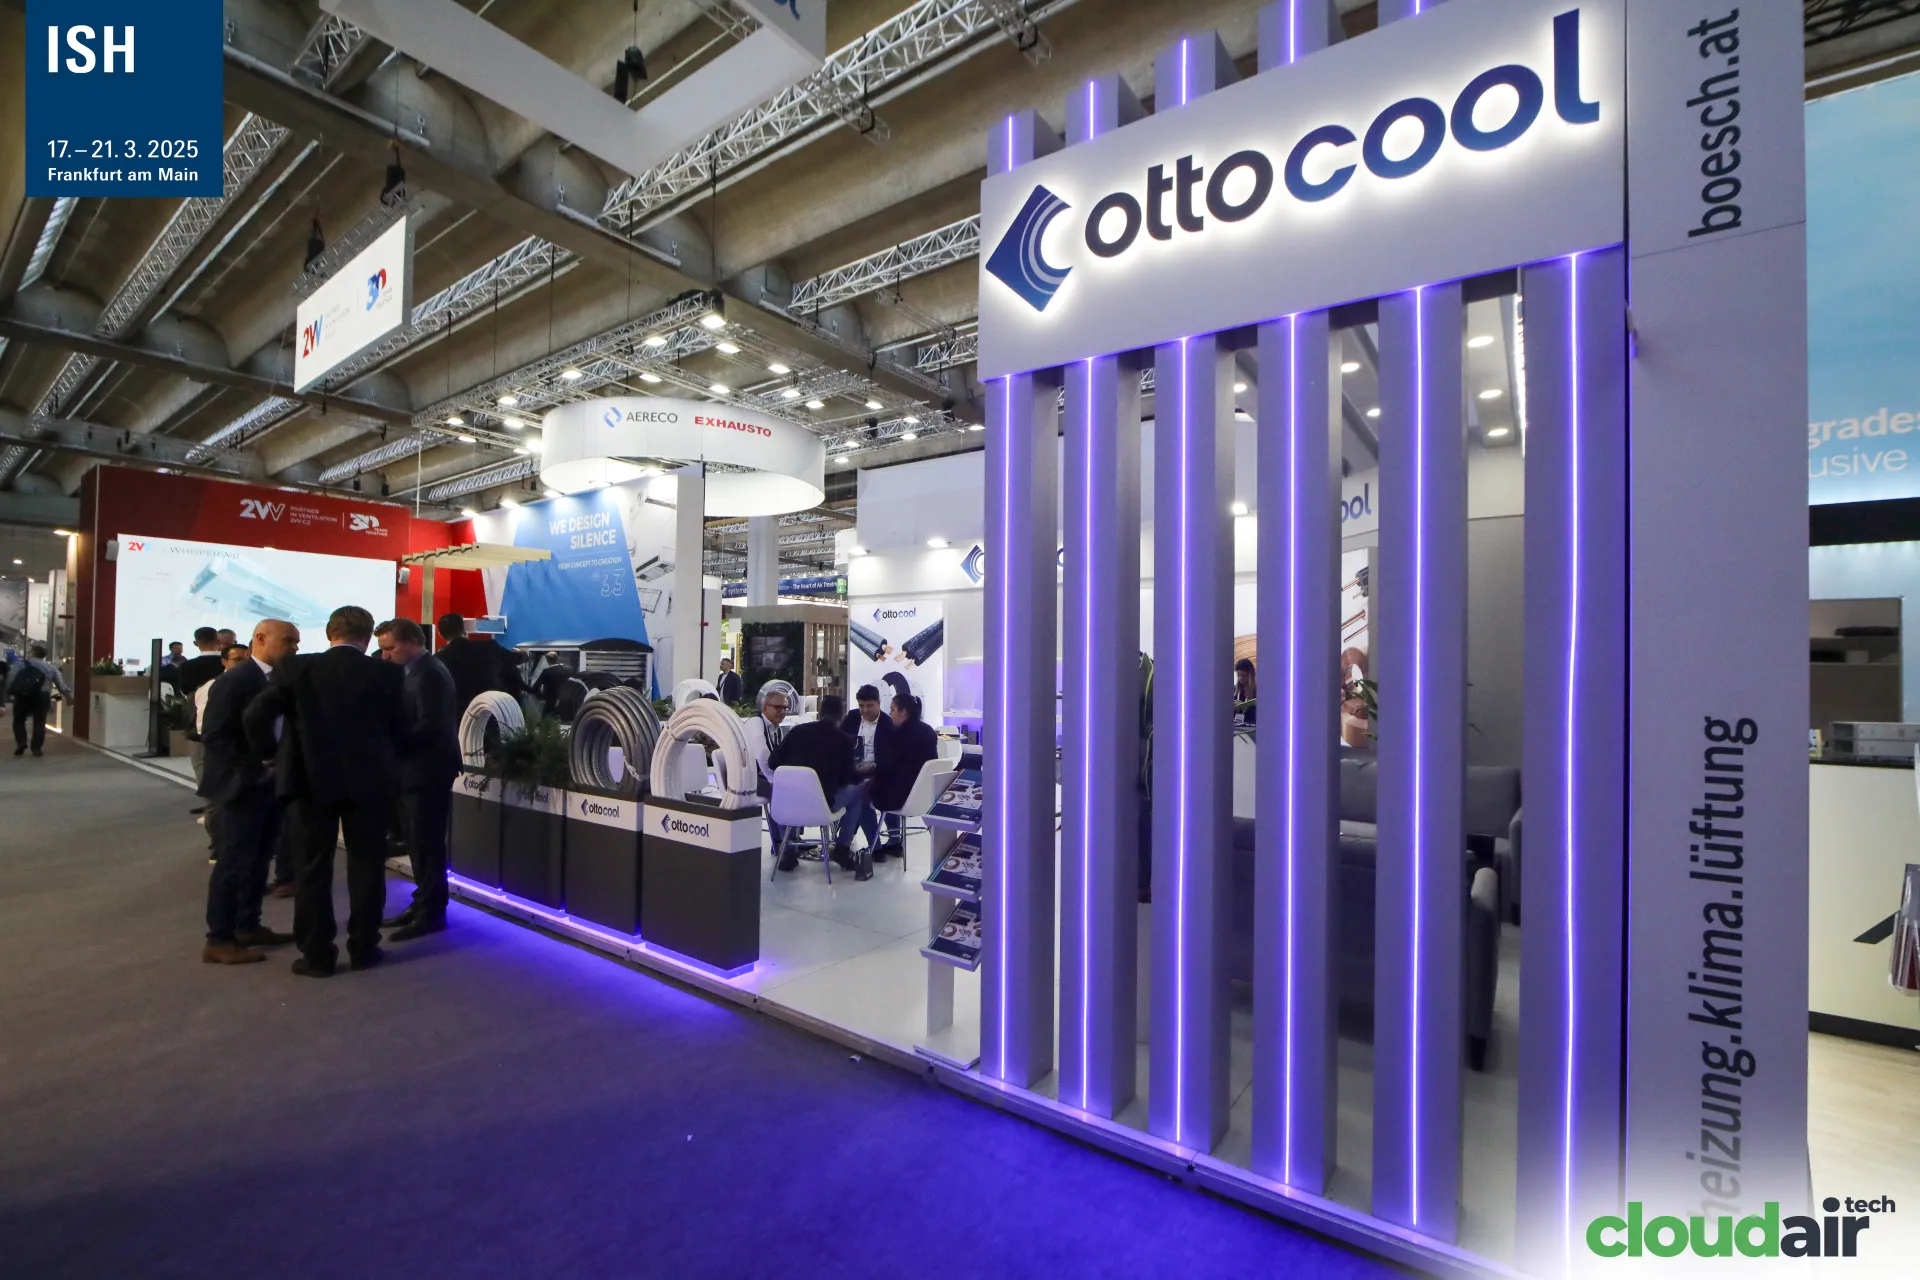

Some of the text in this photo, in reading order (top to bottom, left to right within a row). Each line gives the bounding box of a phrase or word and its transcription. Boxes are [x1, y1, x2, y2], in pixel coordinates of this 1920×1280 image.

[1687, 7, 1743, 238] boesch.at
[626, 411, 772, 437] AERECO EXHAUSTO
[1808, 407, 1920, 450] grade
[290, 505, 320, 515] PARTNER
[549, 512, 610, 535] WE DESIGN
[570, 529, 617, 550] SILENCE
[588, 802, 620, 818] ottocool
[671, 819, 710, 837] ottocool
